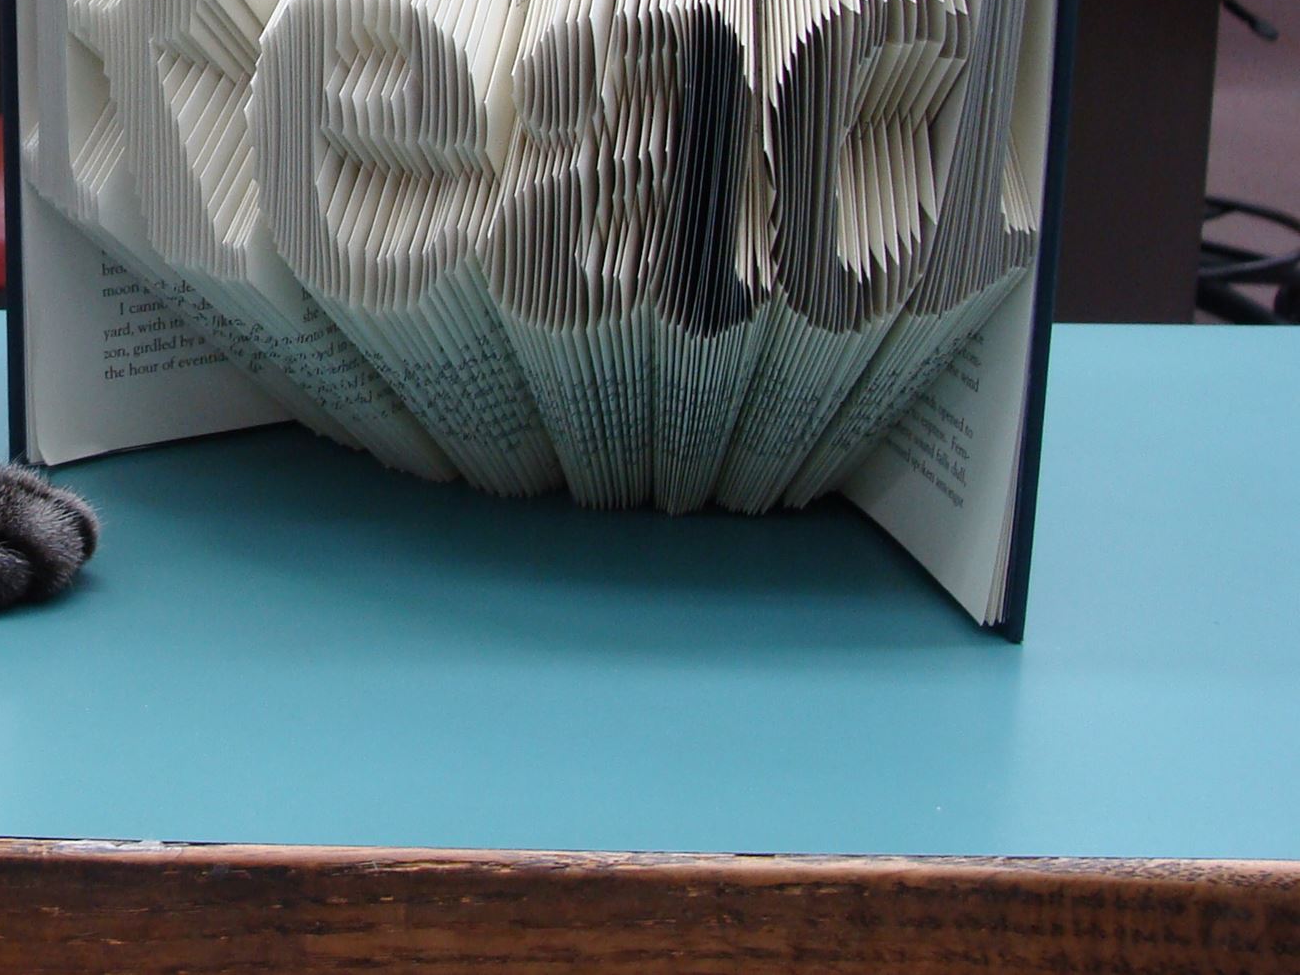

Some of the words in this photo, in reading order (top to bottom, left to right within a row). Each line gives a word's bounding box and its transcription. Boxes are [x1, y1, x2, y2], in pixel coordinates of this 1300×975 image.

[102, 282, 140, 298] moon
[102, 322, 134, 341] yard,
[137, 315, 167, 333] with
[132, 334, 178, 358] girdled
[104, 365, 126, 380] the
[128, 362, 160, 377] hour
[161, 355, 176, 371] of
